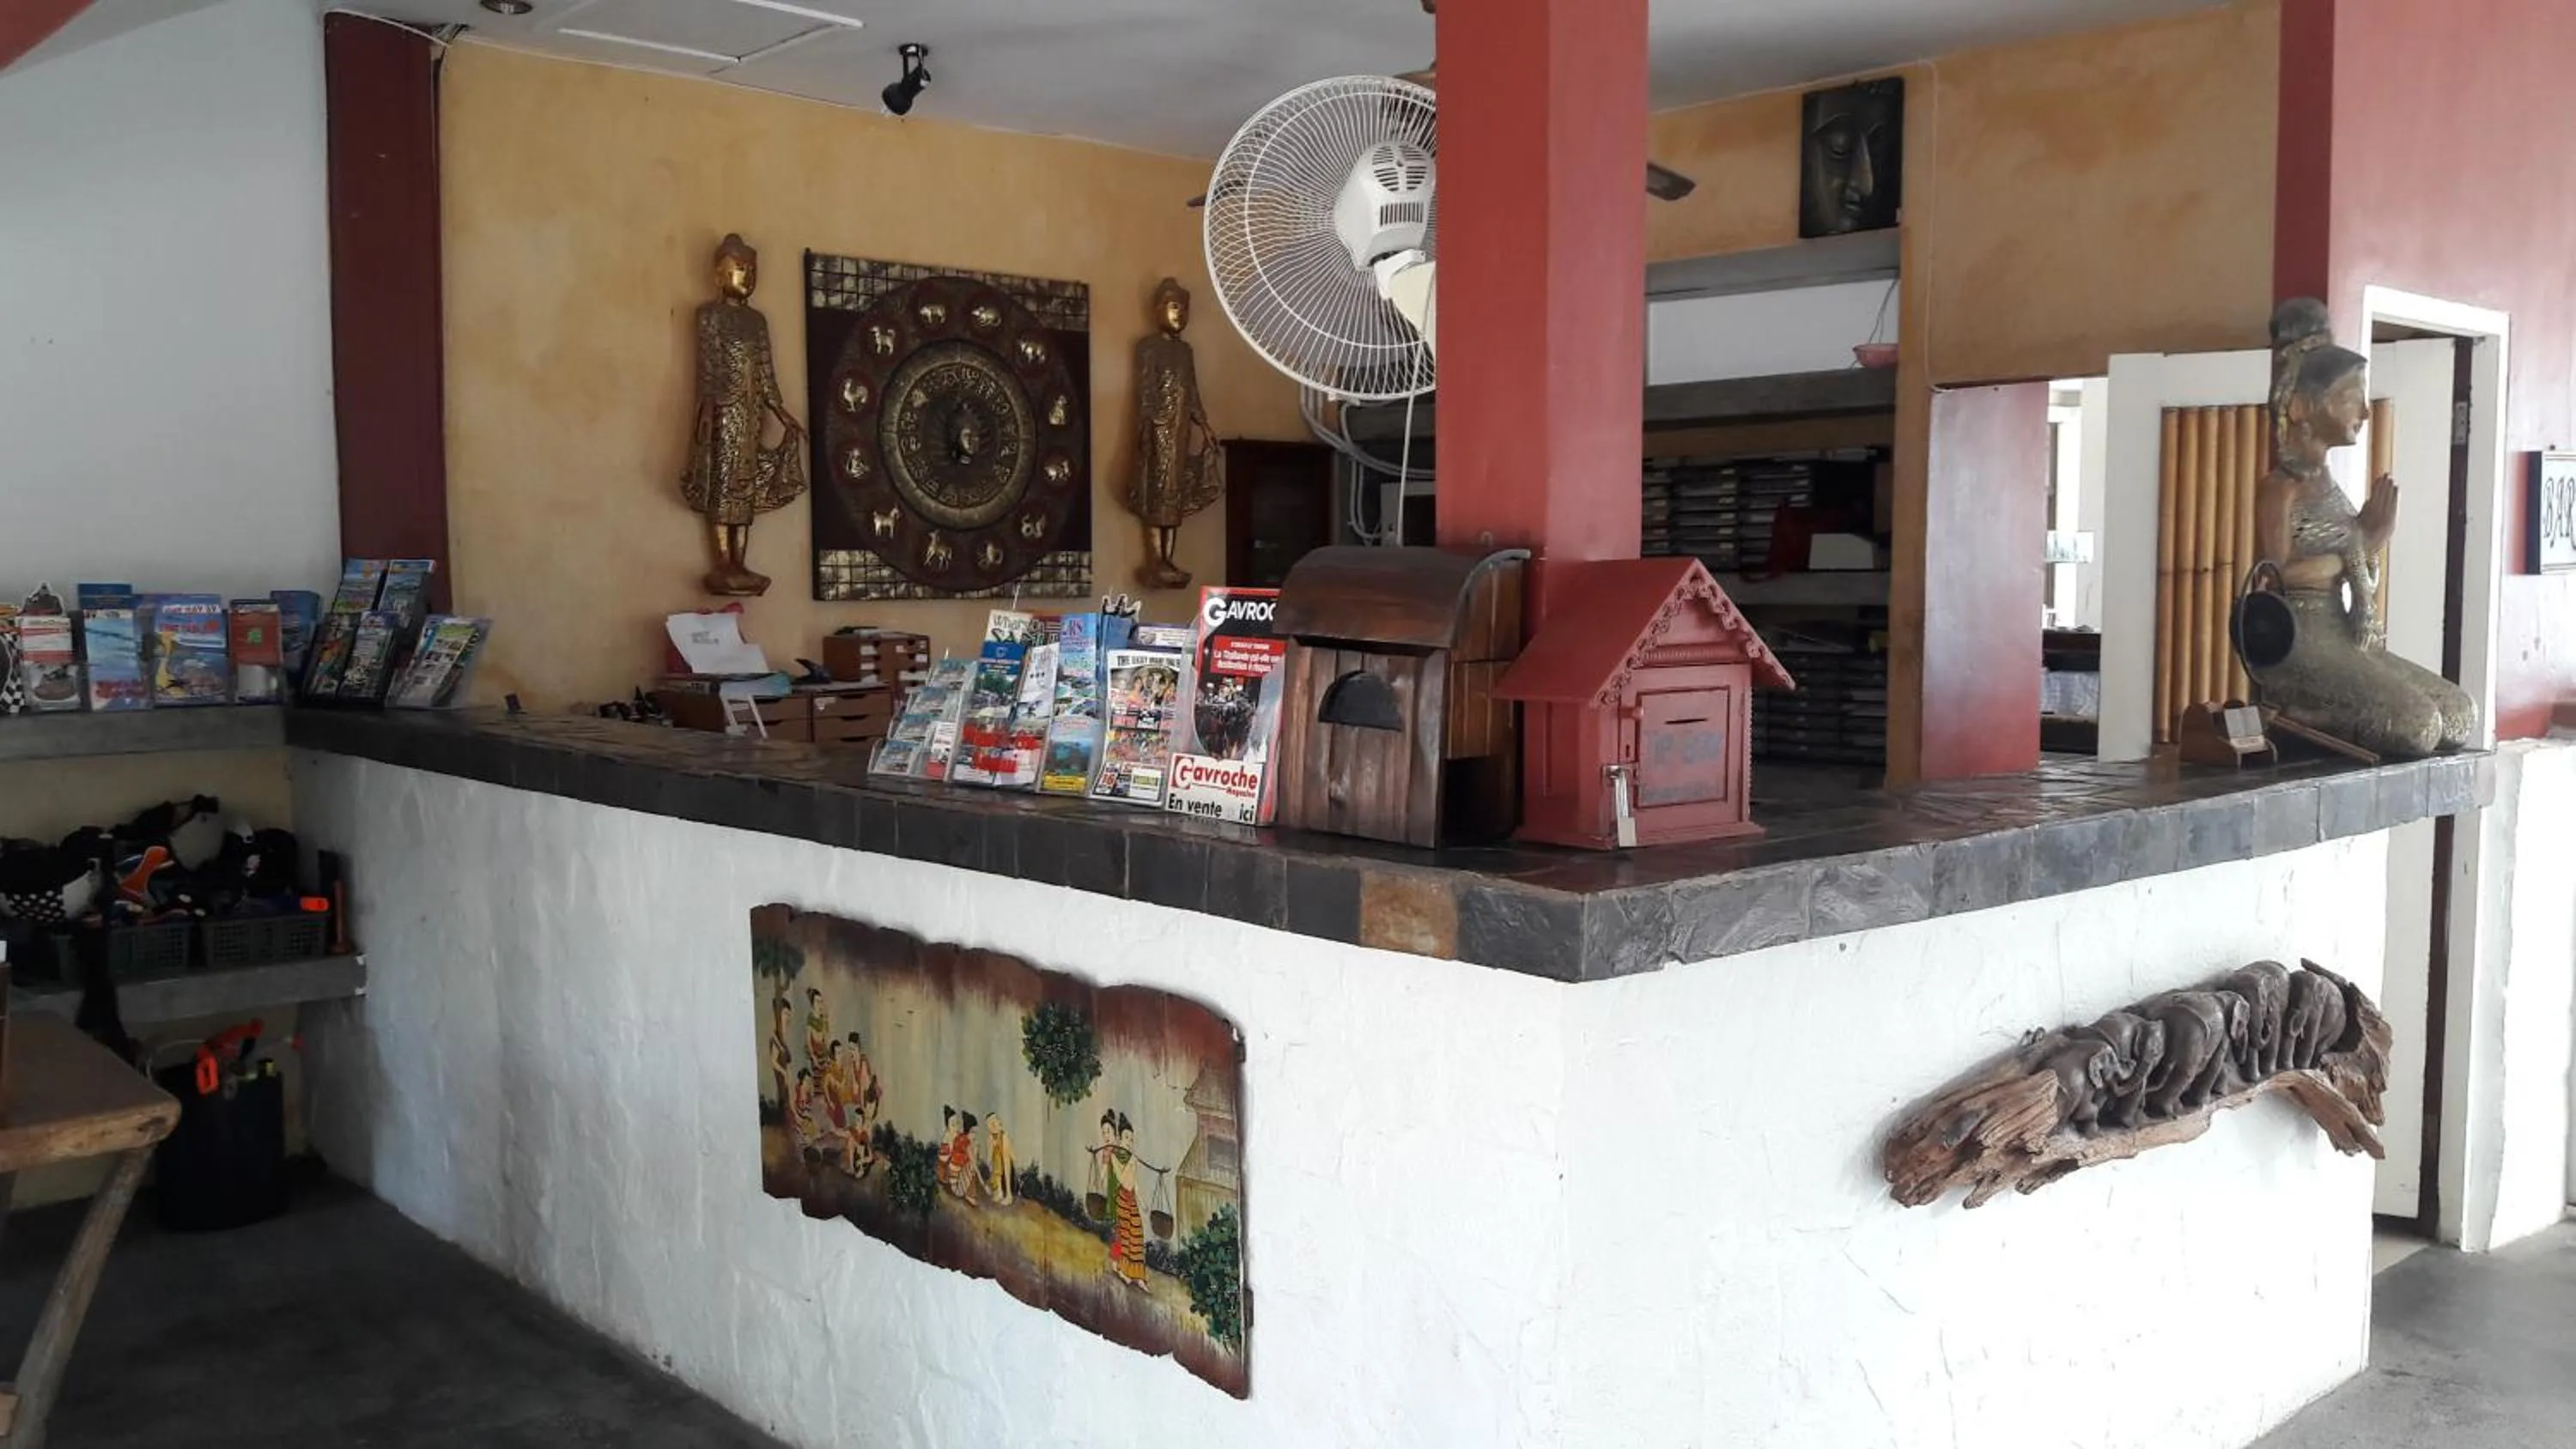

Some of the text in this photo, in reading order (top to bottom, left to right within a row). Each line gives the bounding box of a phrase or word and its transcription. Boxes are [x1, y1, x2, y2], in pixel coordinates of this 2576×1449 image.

[1171, 755, 1258, 791] Gavroche
[1169, 793, 1255, 822] En vente ici
